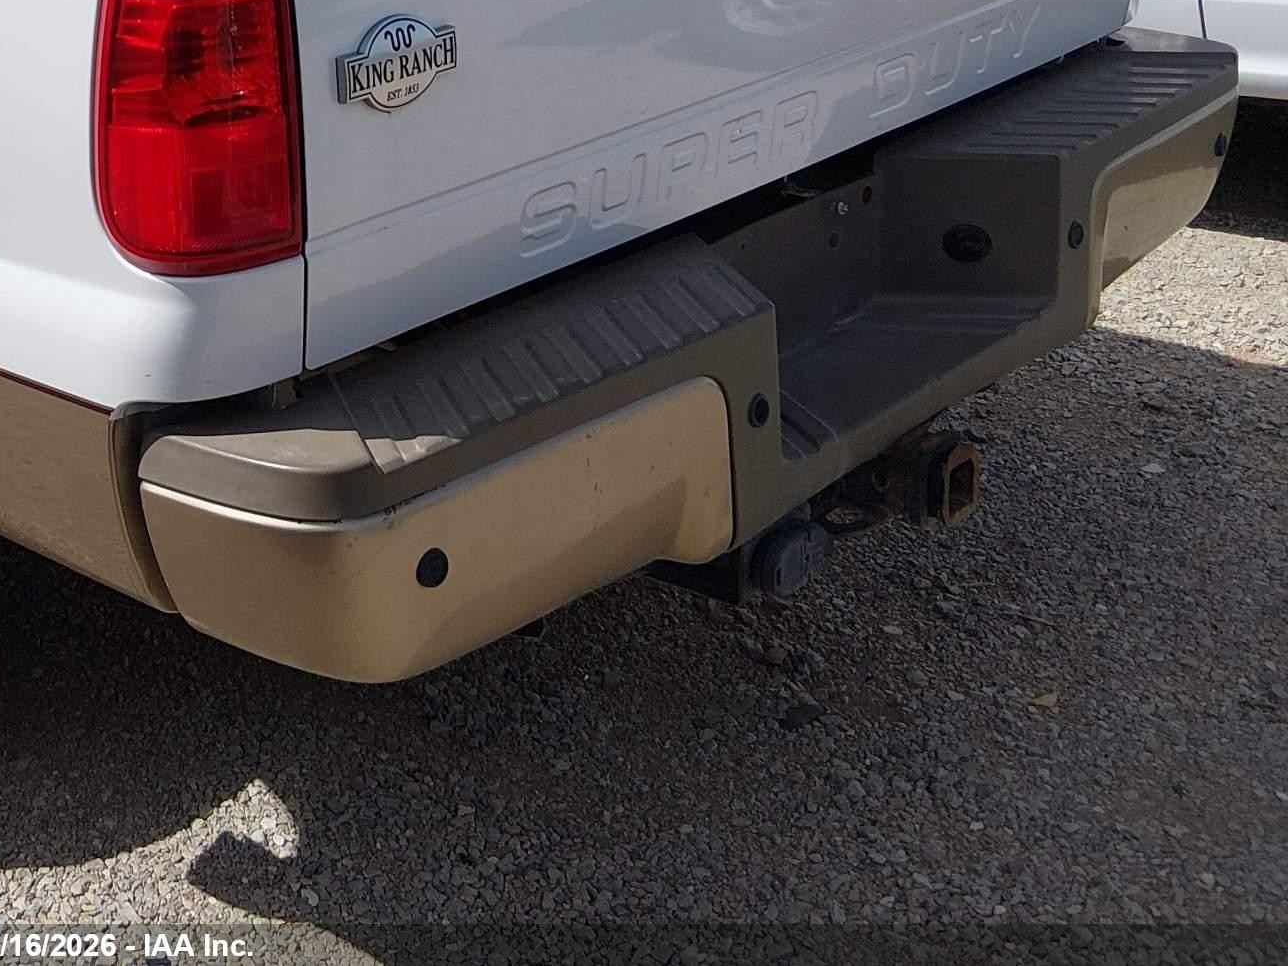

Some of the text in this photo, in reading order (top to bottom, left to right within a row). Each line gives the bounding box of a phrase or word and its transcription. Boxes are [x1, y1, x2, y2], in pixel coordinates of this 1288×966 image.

[350, 37, 455, 94] KING RANCH
[520, 1, 1042, 259] SUPER DUTY
